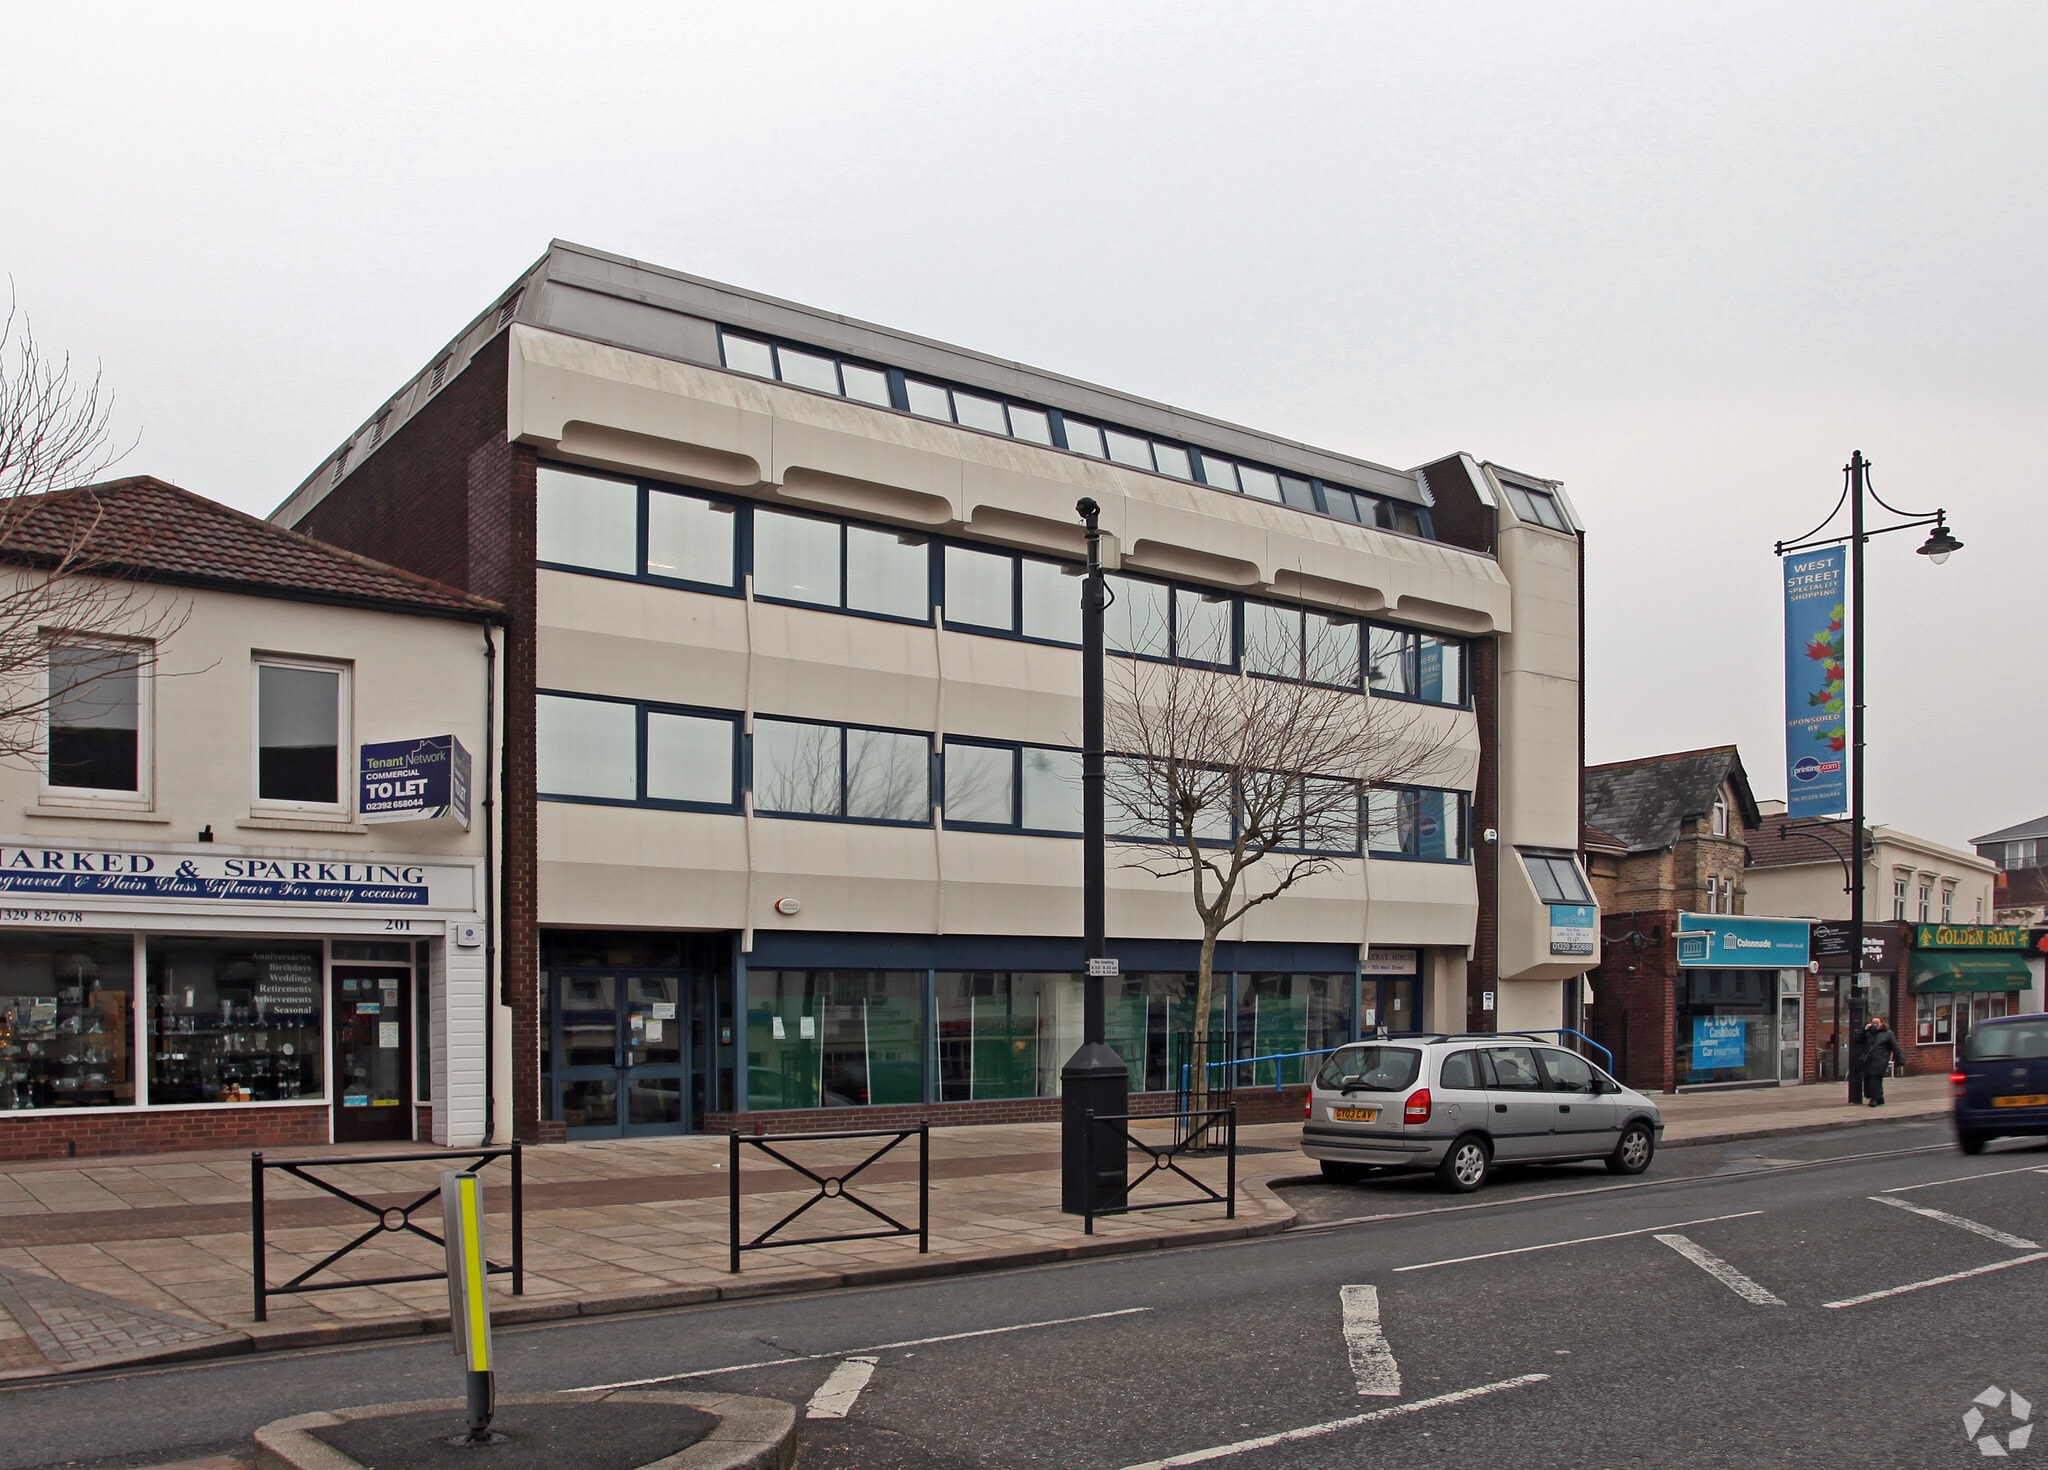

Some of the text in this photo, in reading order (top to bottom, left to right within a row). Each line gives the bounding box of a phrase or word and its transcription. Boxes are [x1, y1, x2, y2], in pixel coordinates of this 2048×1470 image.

[1794, 558, 1834, 573] WEST
[1788, 570, 1840, 587] STREET
[1789, 581, 1839, 594] SPECIALITY
[1790, 589, 1837, 601] SHOPPING
[1788, 714, 1840, 727] SPONSORED
[366, 750, 446, 769] Tenant Network
[366, 769, 420, 780] COMMERCIAL
[366, 778, 428, 799] TO LET
[366, 802, 392, 811] 02392
[175, 860, 200, 879] &
[224, 859, 424, 884] SPARKLING
[0, 874, 67, 891] graved
[97, 874, 148, 891] Plain
[155, 876, 197, 892] Glass
[205, 879, 272, 899] Giftware
[278, 882, 308, 896] For
[315, 887, 354, 902] every
[360, 888, 418, 900] occasion
[34, 911, 83, 922] 827678
[384, 919, 411, 931] 201
[1737, 938, 1771, 948] Colonnade
[1936, 929, 1984, 946] GOLDEN
[1987, 930, 2017, 946] BOAT
[252, 953, 311, 961] Anniversaries
[269, 963, 311, 973] Birthdays
[269, 974, 311, 984] Weddings
[260, 984, 312, 992] Retirements
[251, 995, 312, 1003] Achievements
[274, 1006, 312, 1014] Seasonal
[1336, 1110, 1373, 1120] GY03 CAV
